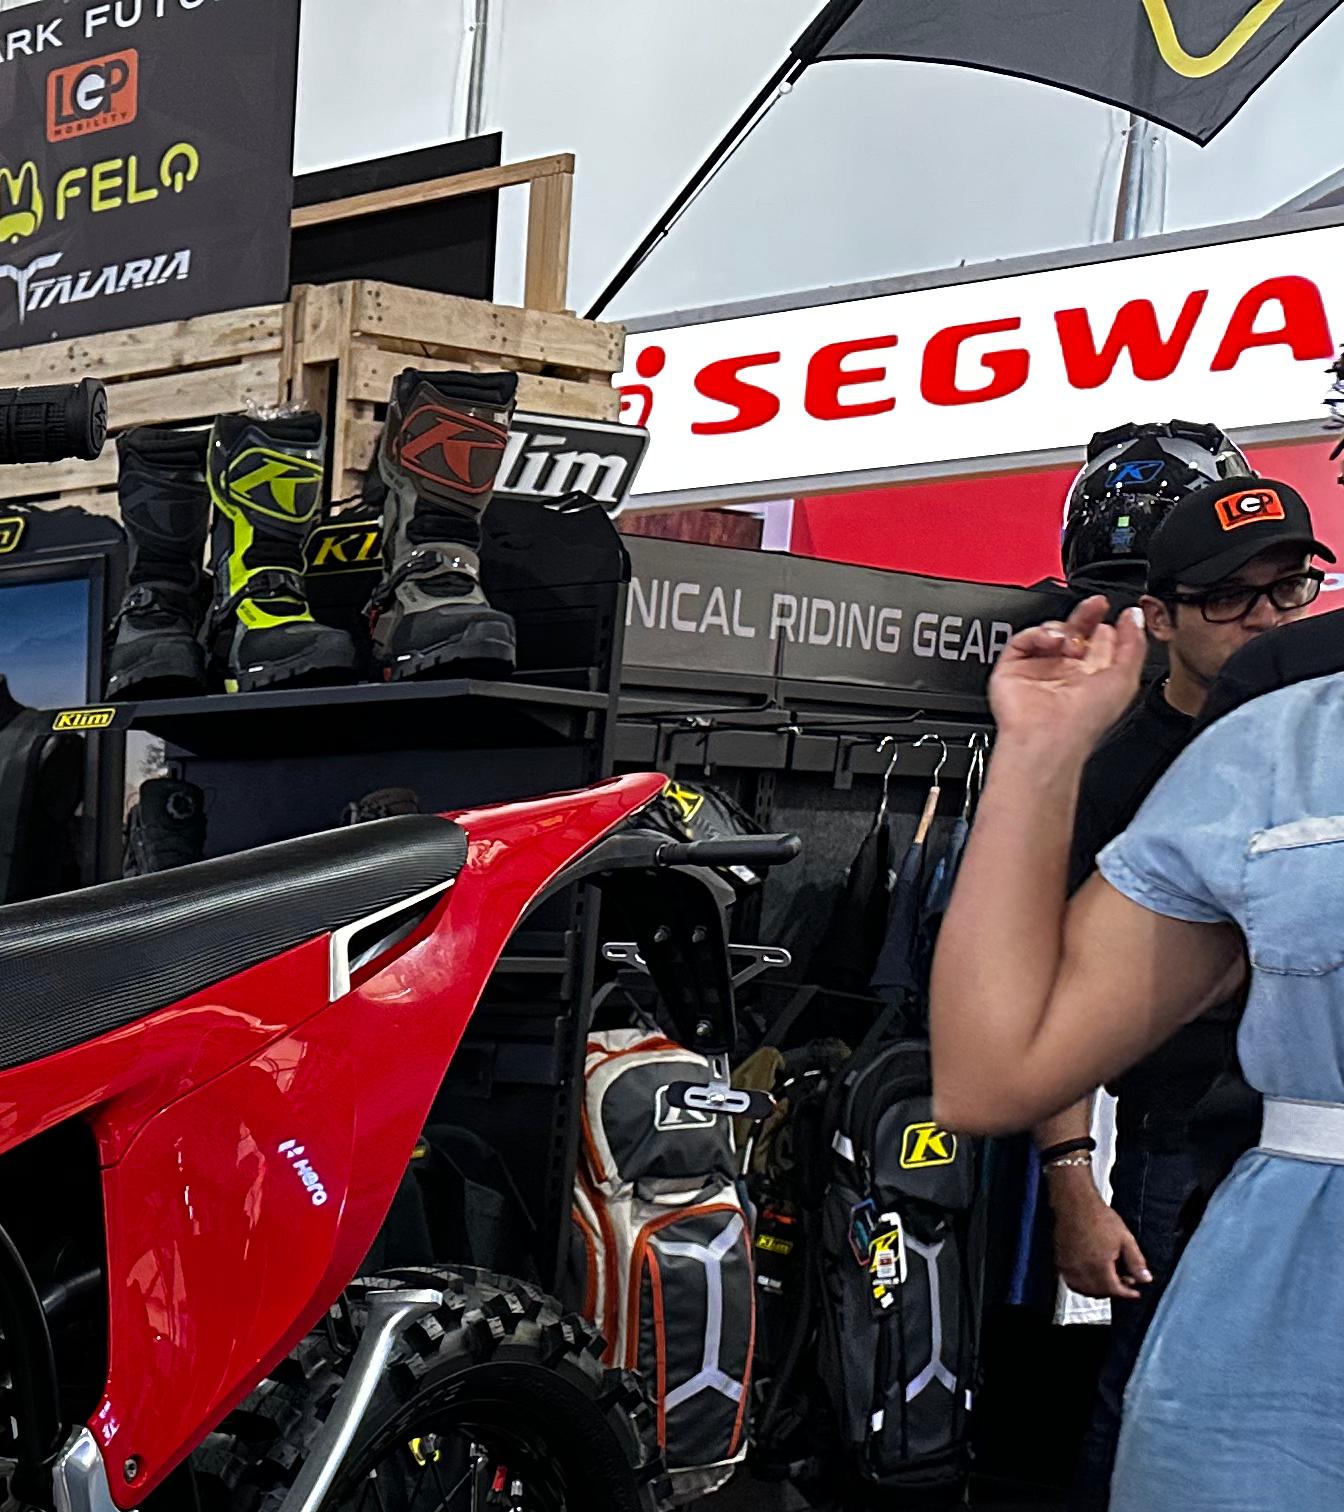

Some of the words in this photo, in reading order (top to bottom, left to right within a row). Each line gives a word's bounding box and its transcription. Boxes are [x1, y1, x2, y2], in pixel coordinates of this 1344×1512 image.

[84, 0, 205, 38] FU
[691, 275, 1334, 436] SEGWA
[492, 430, 629, 503] lim
[625, 577, 756, 639] NICAL
[769, 592, 903, 654] RIDING
[912, 611, 1013, 665] GEAR
[57, 709, 111, 728] Klim
